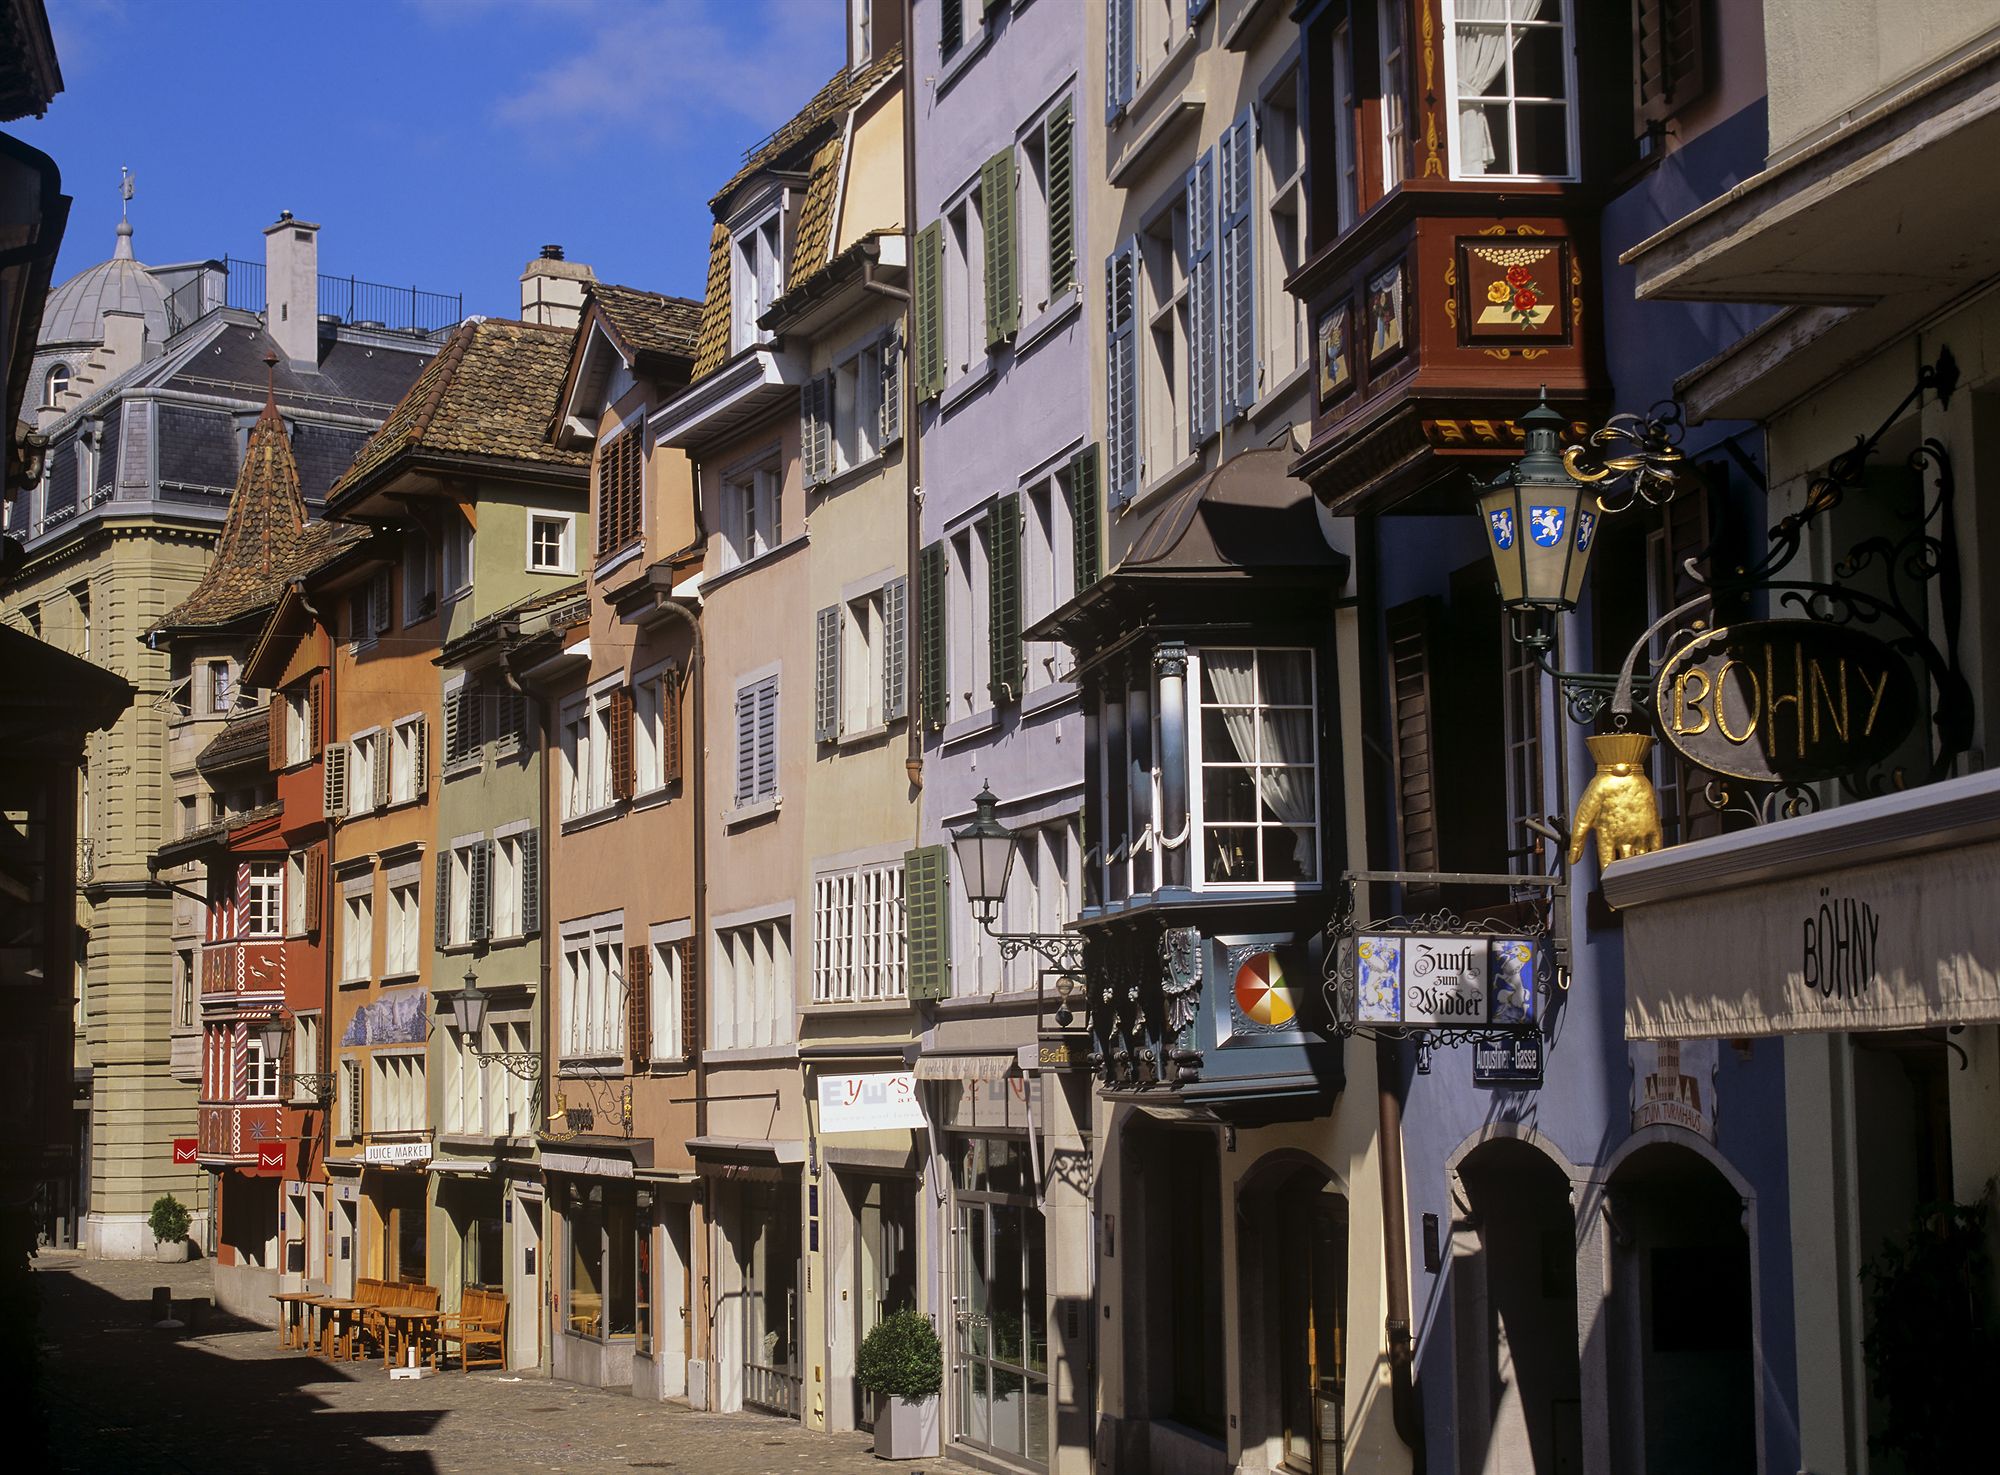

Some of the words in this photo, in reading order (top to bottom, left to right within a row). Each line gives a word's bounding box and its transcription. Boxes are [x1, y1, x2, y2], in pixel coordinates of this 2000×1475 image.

[1803, 887, 1879, 1000] BÖHNY
[1413, 944, 1480, 977] Zunft
[1433, 976, 1459, 986] zum
[1408, 986, 1483, 1015] Widder
[1644, 1104, 1661, 1124] ZUM
[369, 1148, 391, 1159] JUICE
[395, 1145, 427, 1157] MARKET
